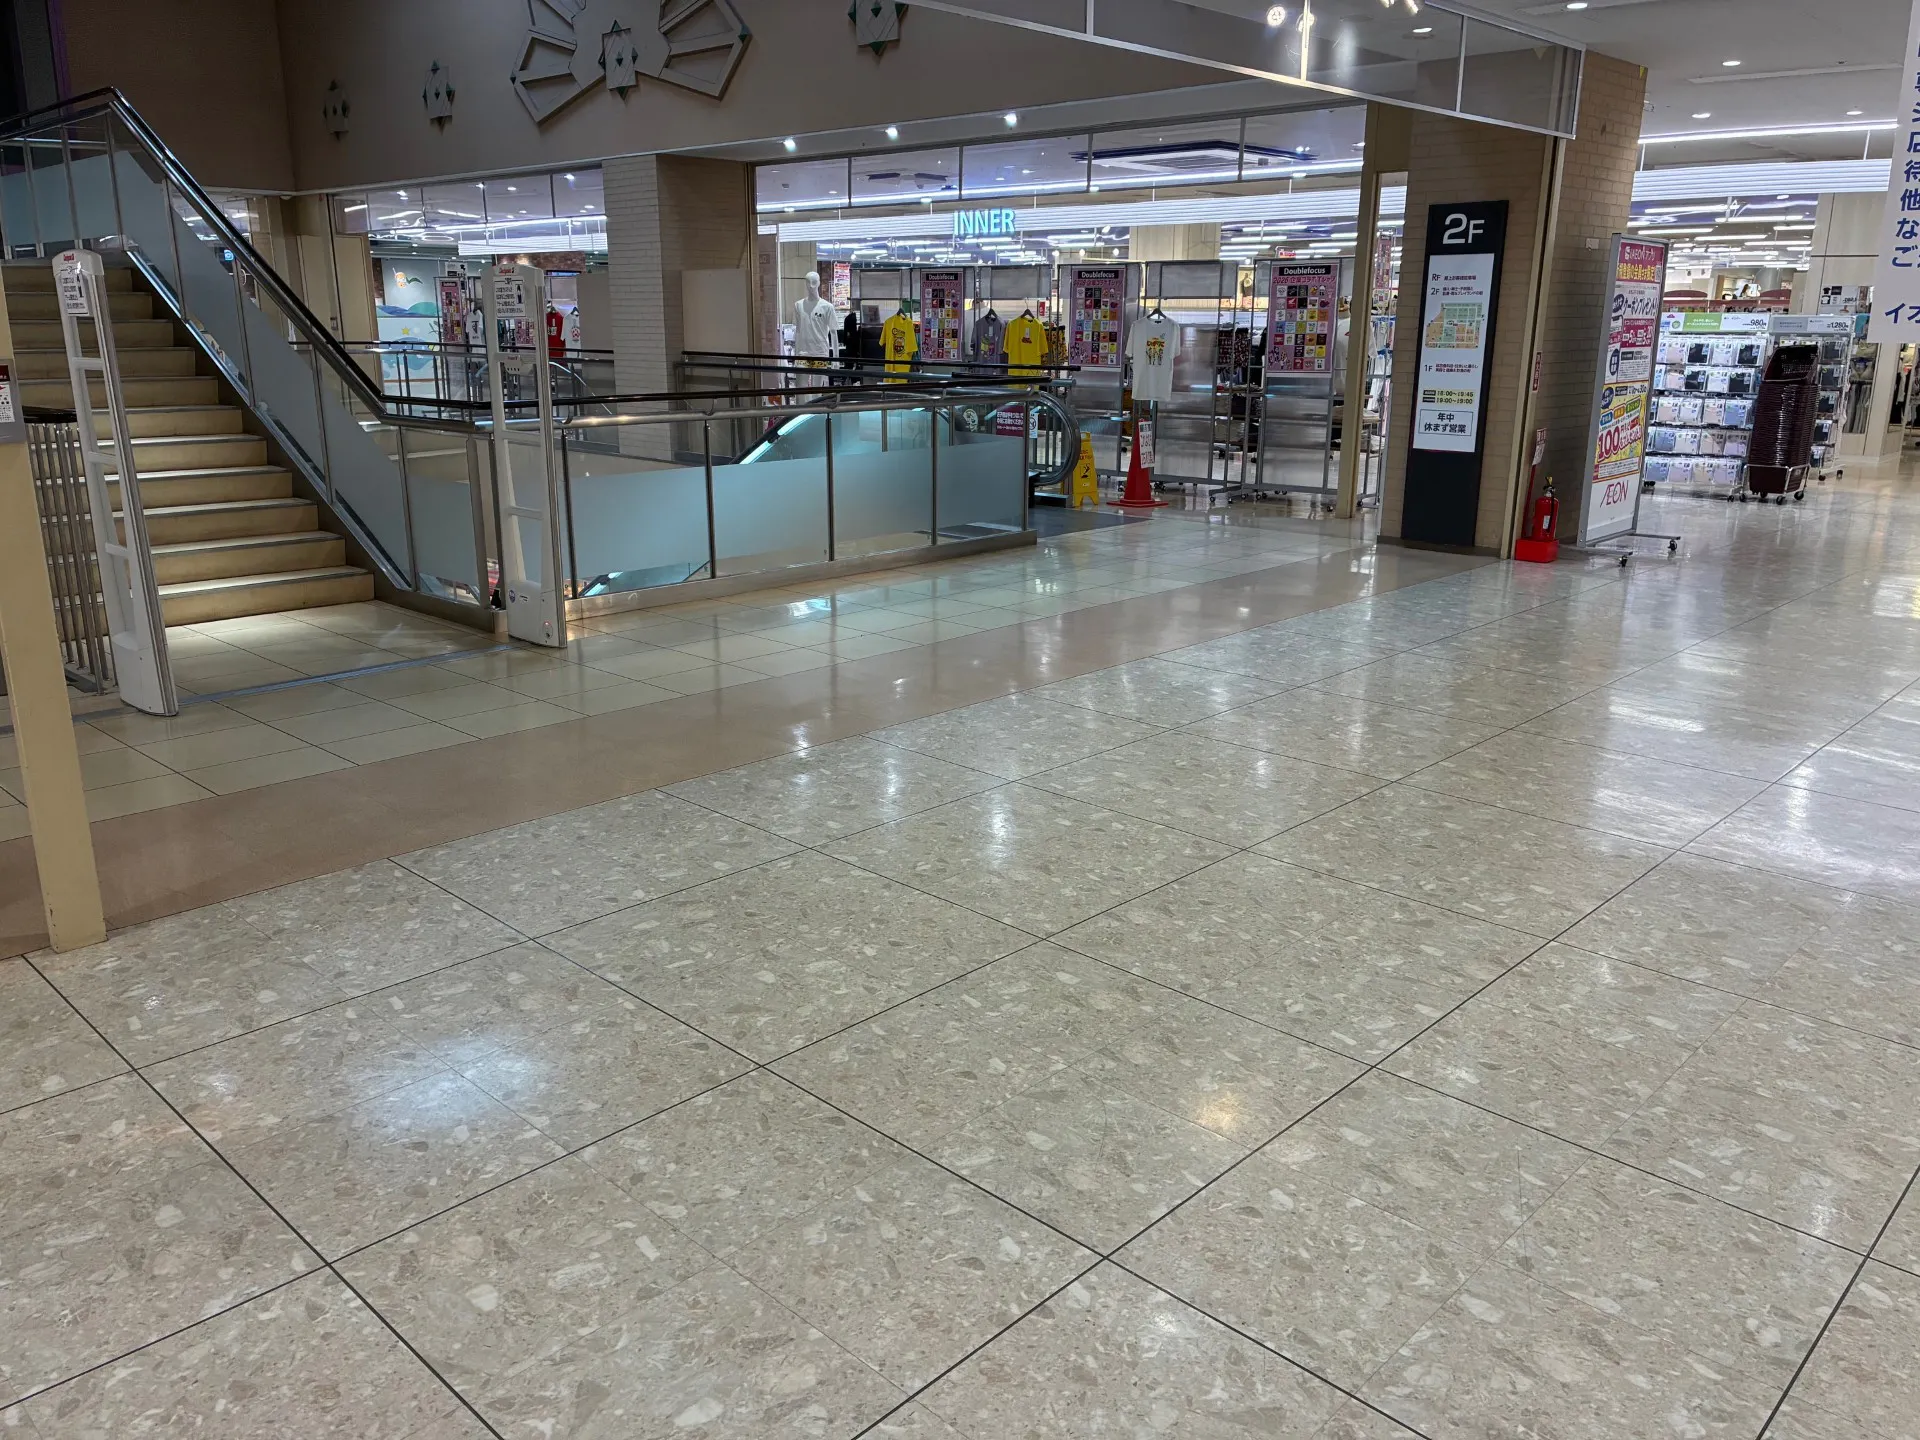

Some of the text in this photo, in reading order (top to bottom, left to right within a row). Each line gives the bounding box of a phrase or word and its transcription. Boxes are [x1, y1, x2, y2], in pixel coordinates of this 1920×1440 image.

[953, 208, 1015, 235] INNER
[1443, 213, 1485, 244] 2F
[1284, 266, 1326, 275] Doublefocus
[1432, 273, 1441, 281] RF
[1431, 287, 1440, 295] 2F
[1424, 364, 1433, 372] 1F
[1437, 412, 1455, 422] 年中
[1424, 422, 1467, 433] 休まず営業
